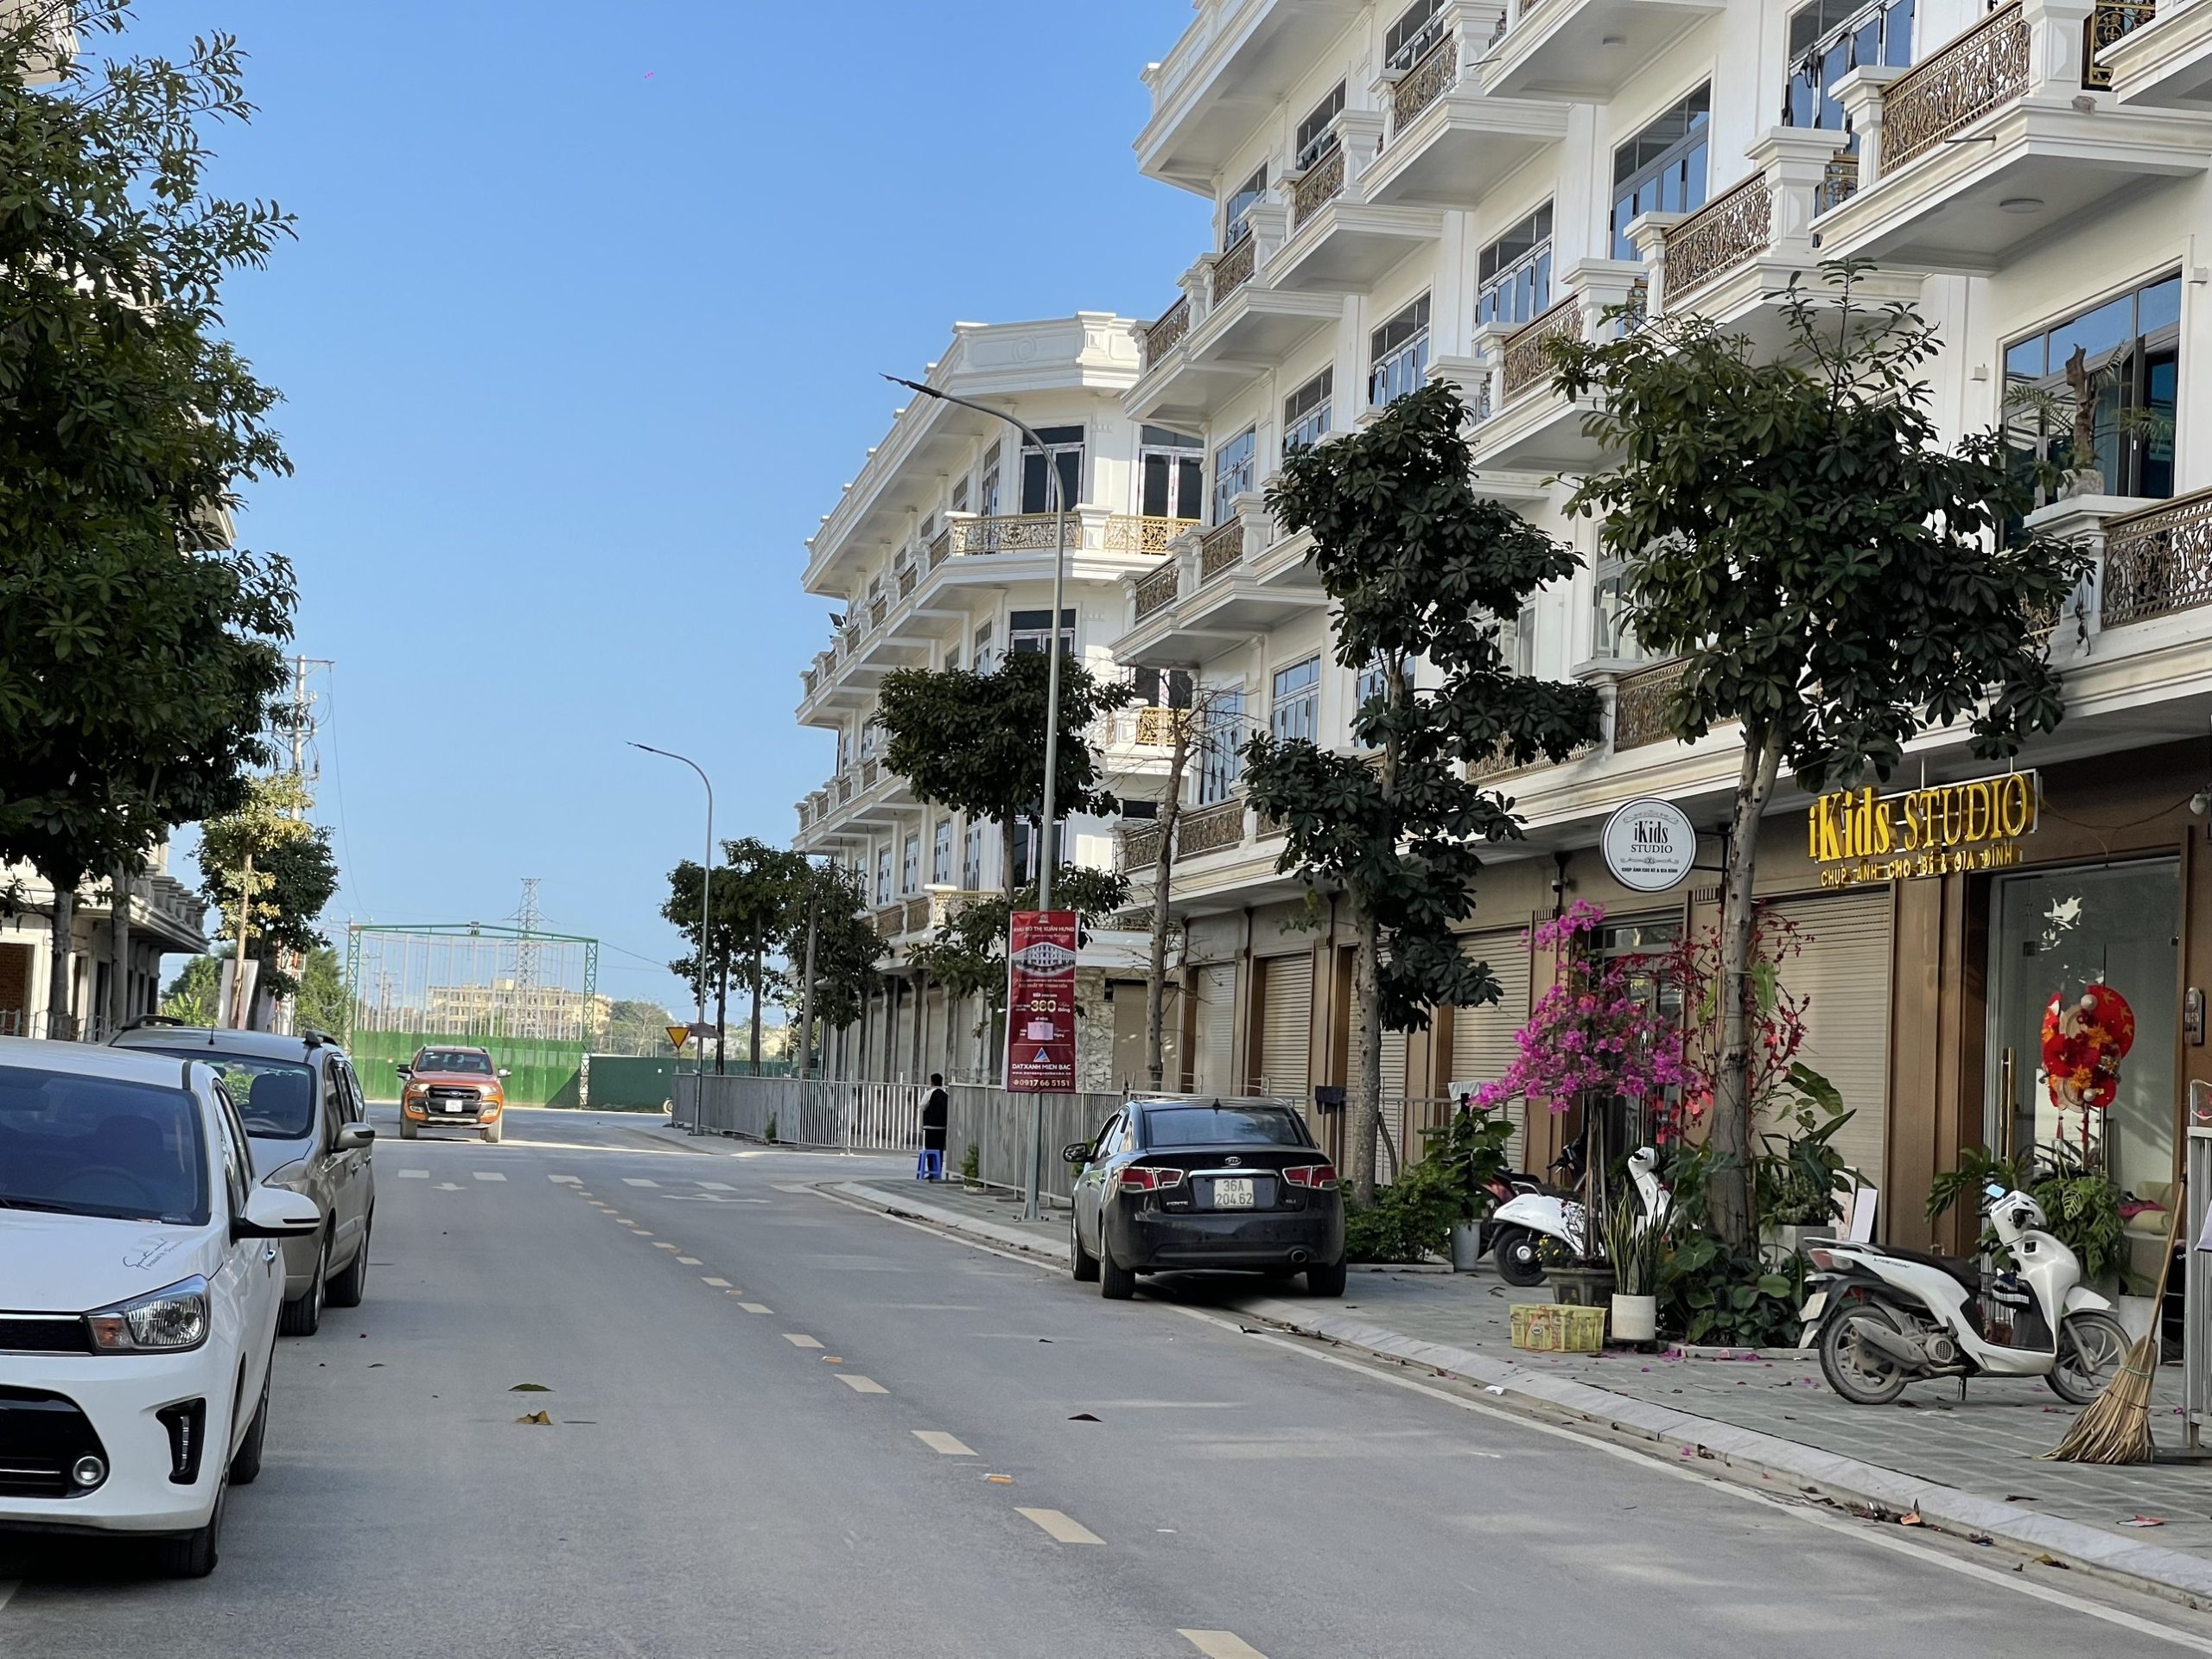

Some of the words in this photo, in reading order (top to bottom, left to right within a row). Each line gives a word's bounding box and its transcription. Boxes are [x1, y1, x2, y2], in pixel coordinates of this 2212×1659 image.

[1809, 787, 1889, 861] iKids
[1904, 773, 2028, 851] STUDIO
[1634, 821, 1669, 843] iKids
[1630, 844, 1673, 853] STUDIO
[1887, 859, 1911, 879] CHO
[1955, 850, 1975, 873] GIA
[1224, 1180, 1244, 1192] 36A
[1216, 1192, 1253, 1205] 204.62
